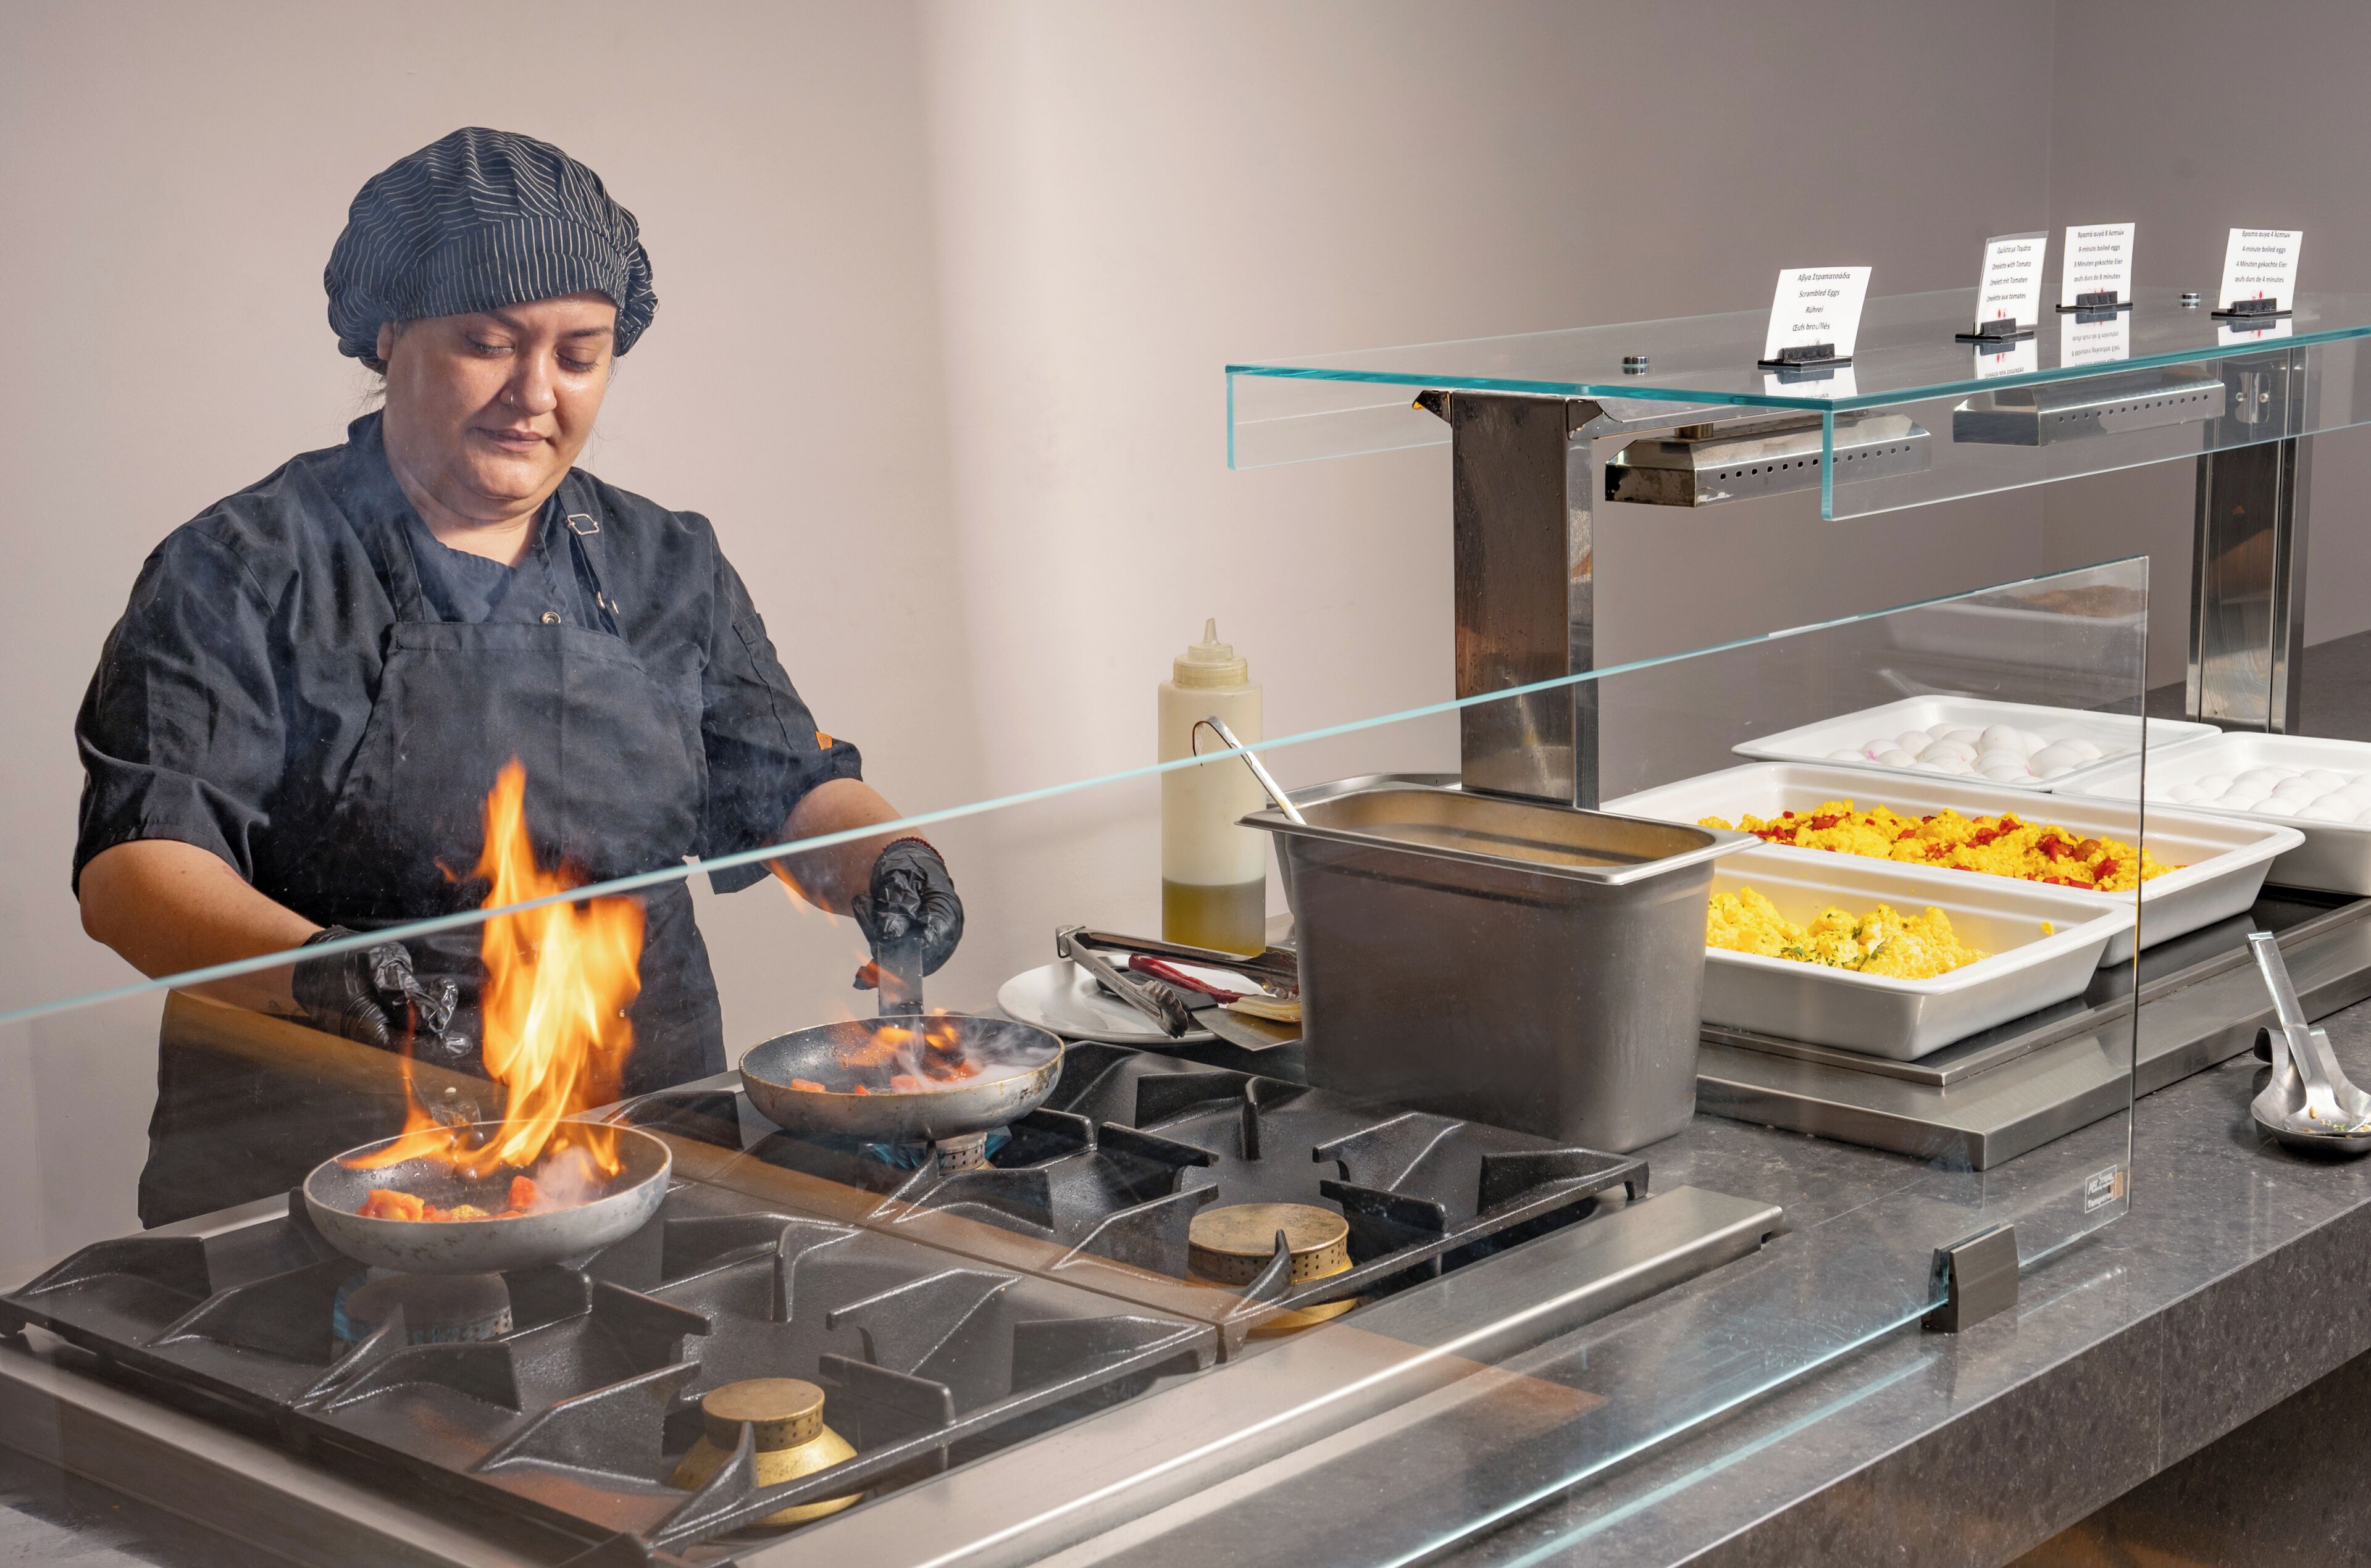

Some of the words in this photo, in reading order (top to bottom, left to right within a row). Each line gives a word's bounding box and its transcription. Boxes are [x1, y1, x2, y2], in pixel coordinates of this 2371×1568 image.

[1813, 272, 1850, 281] Στραπατσάδα
[1799, 289, 1826, 298] Scrambled
[1792, 323, 1805, 332] Œufs
[2088, 1190, 2114, 1208] Tempered
